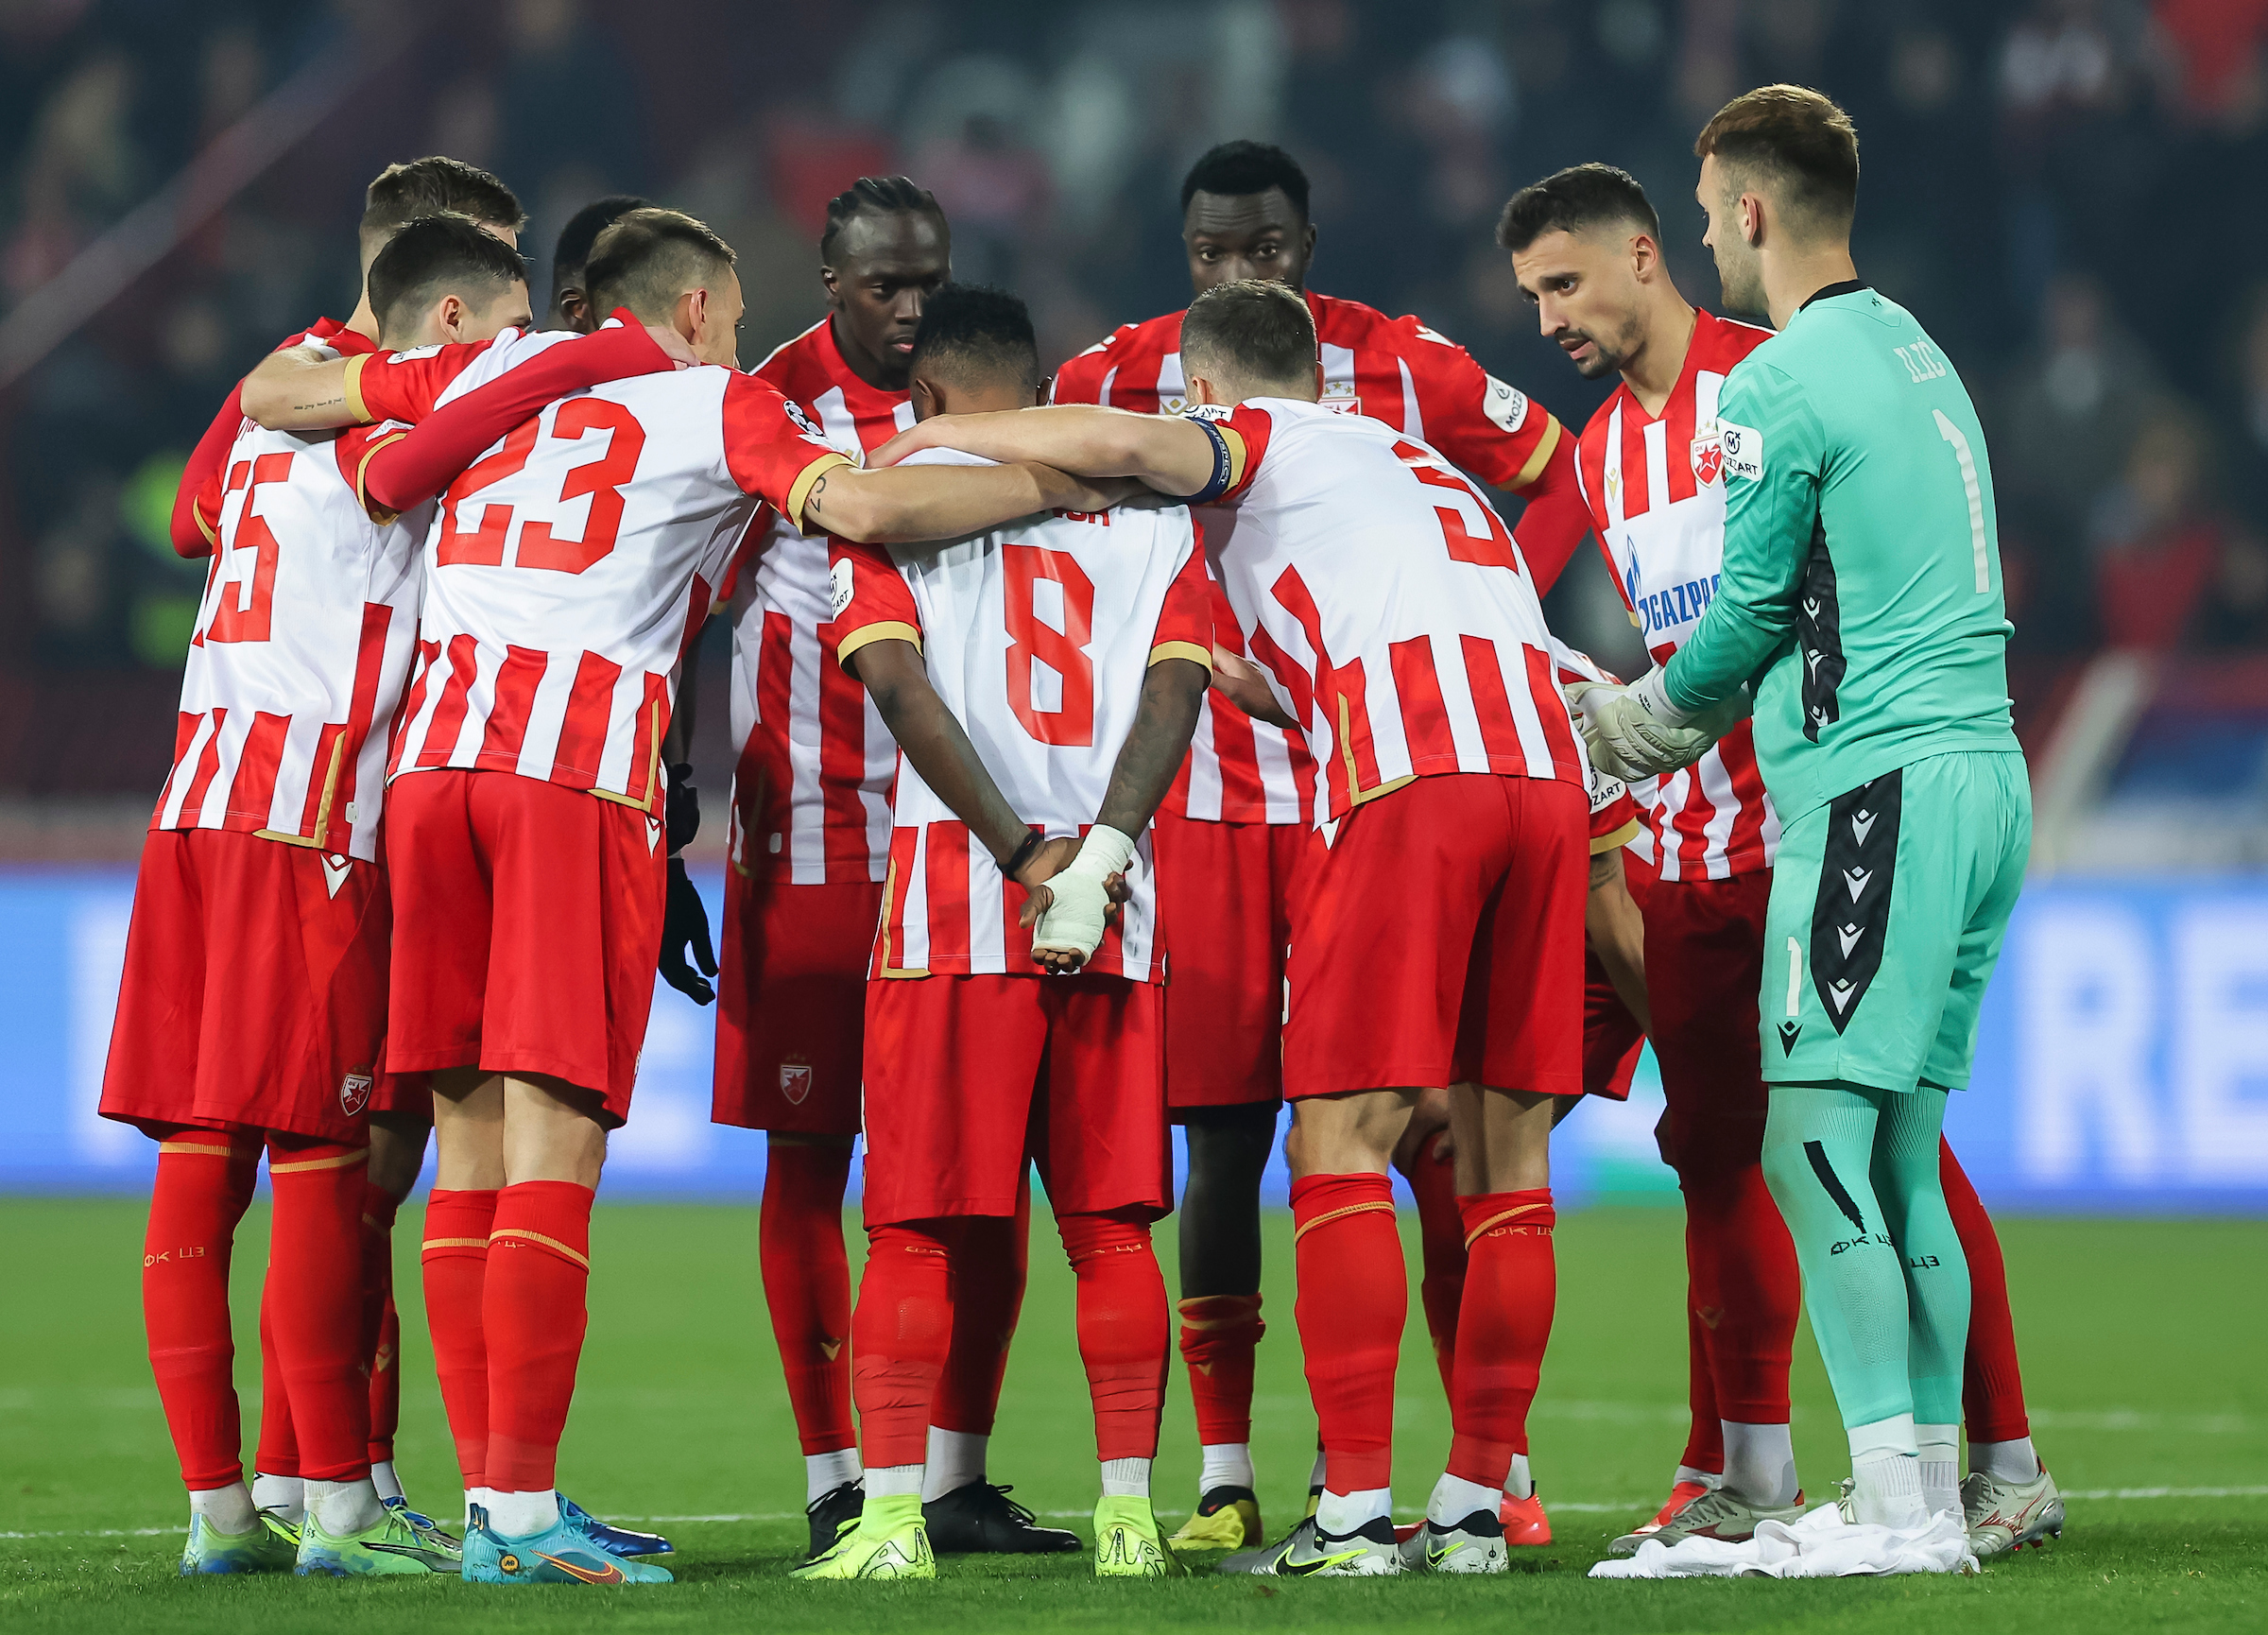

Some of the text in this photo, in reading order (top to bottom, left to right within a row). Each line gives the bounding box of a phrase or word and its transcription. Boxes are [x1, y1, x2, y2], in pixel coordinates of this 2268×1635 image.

[1893, 335, 1947, 384] ILIĆ
[1505, 390, 1522, 428] MOZZ
[437, 397, 646, 576] 23
[1932, 408, 1990, 594] 1
[833, 589, 849, 614] ZART
[1002, 543, 1095, 747] 8
[1592, 782, 1621, 806] ZART
[1786, 937, 1802, 1016] 1
